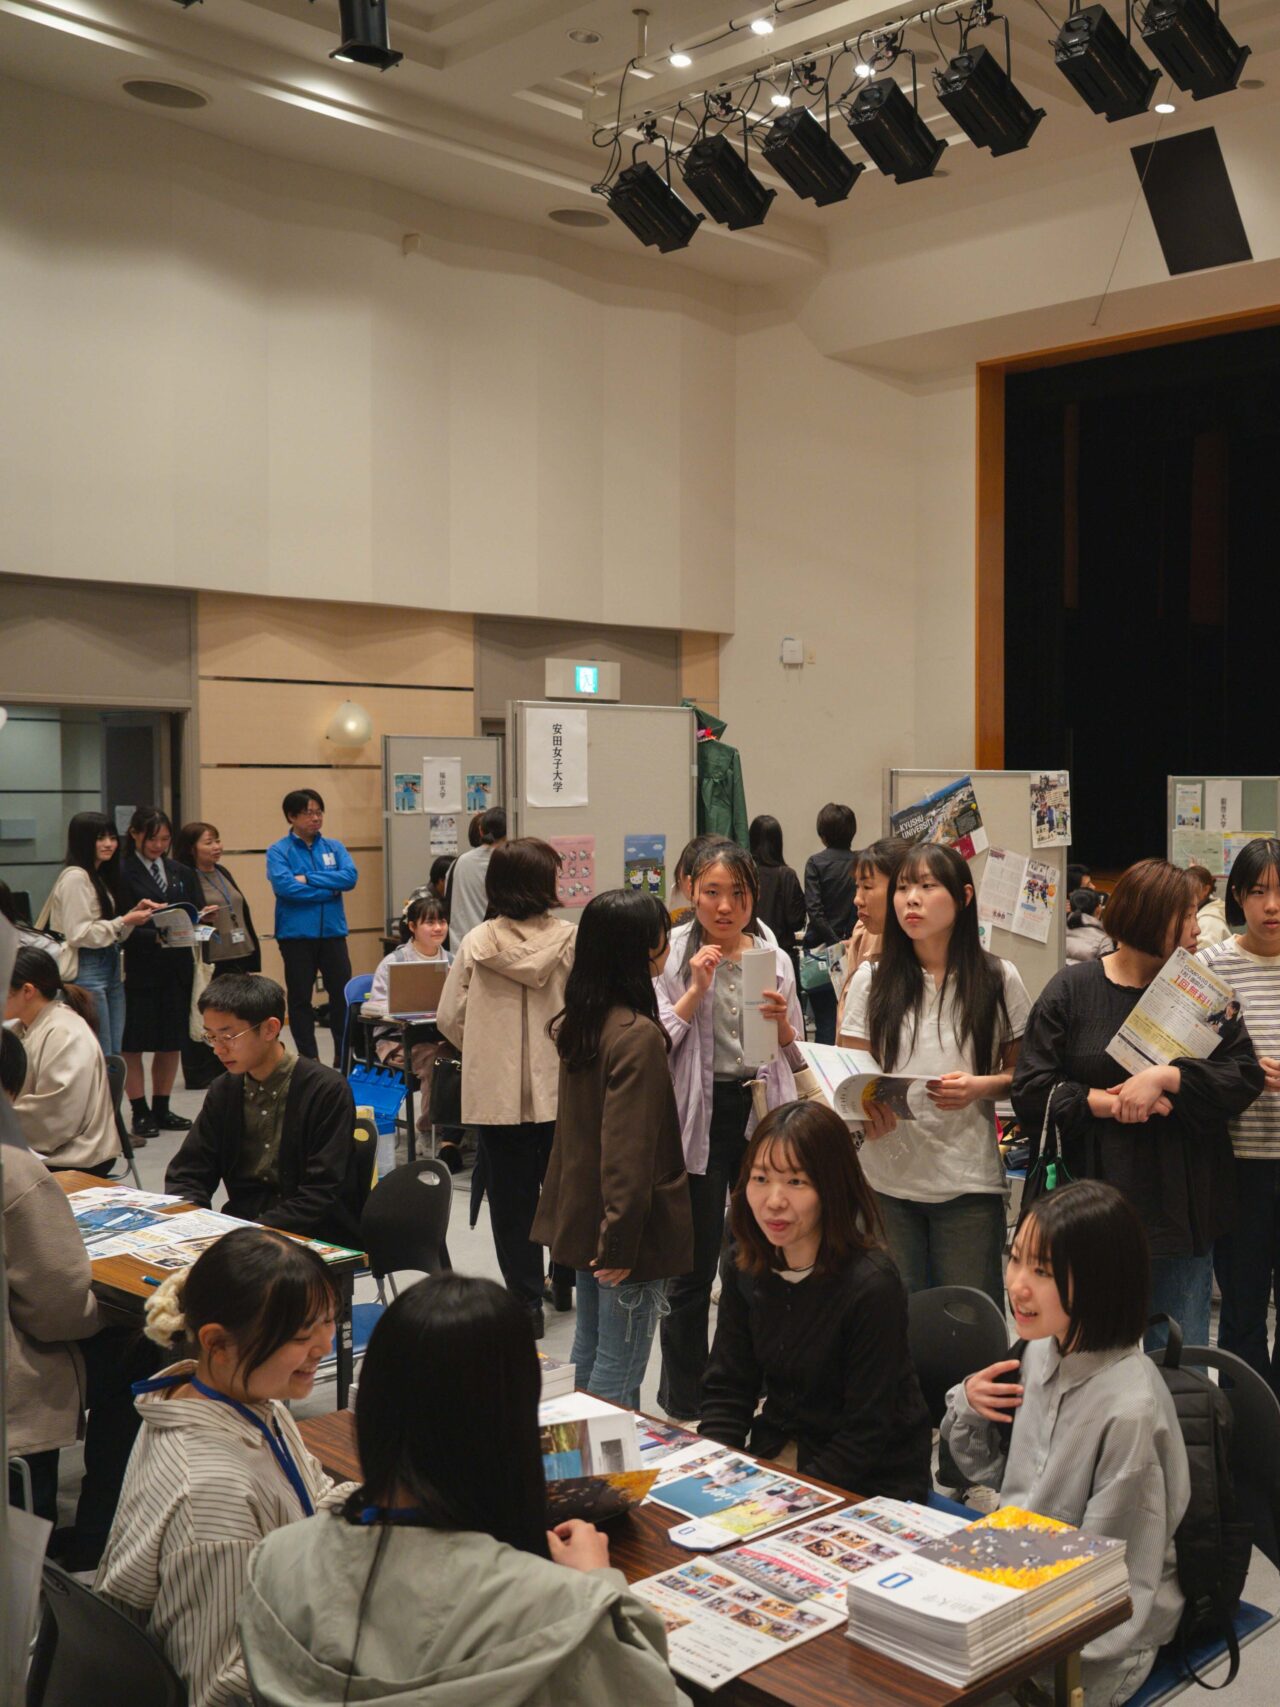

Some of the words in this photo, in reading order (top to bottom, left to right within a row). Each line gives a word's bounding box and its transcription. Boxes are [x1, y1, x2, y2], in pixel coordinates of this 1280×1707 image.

[552, 722, 564, 793] 安田女子大学
[899, 814, 924, 832] KYUSHU
[901, 817, 934, 839] UNIVERSITY
